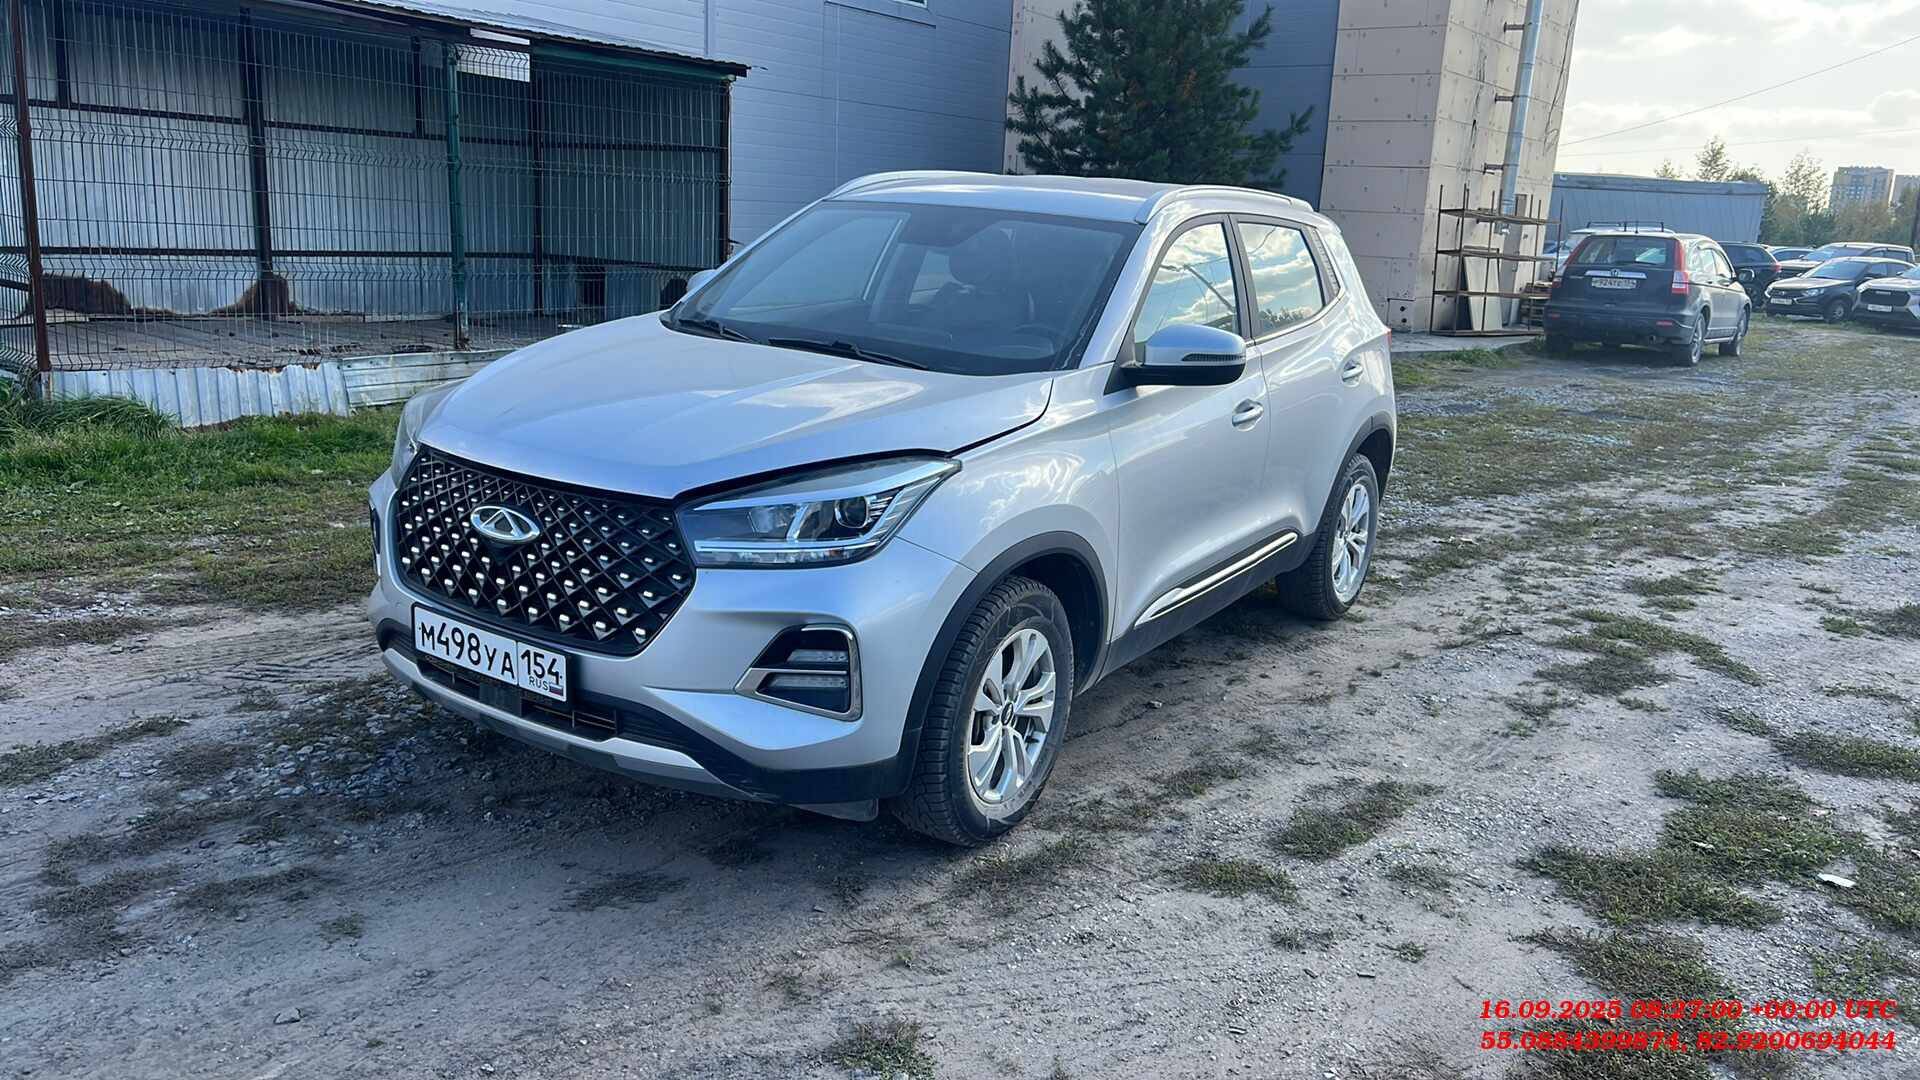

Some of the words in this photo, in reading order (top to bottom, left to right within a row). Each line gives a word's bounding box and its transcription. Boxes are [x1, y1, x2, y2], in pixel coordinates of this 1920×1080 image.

[420, 622, 515, 679] М498УА
[521, 650, 560, 685] 154
[529, 675, 549, 691] RUS
